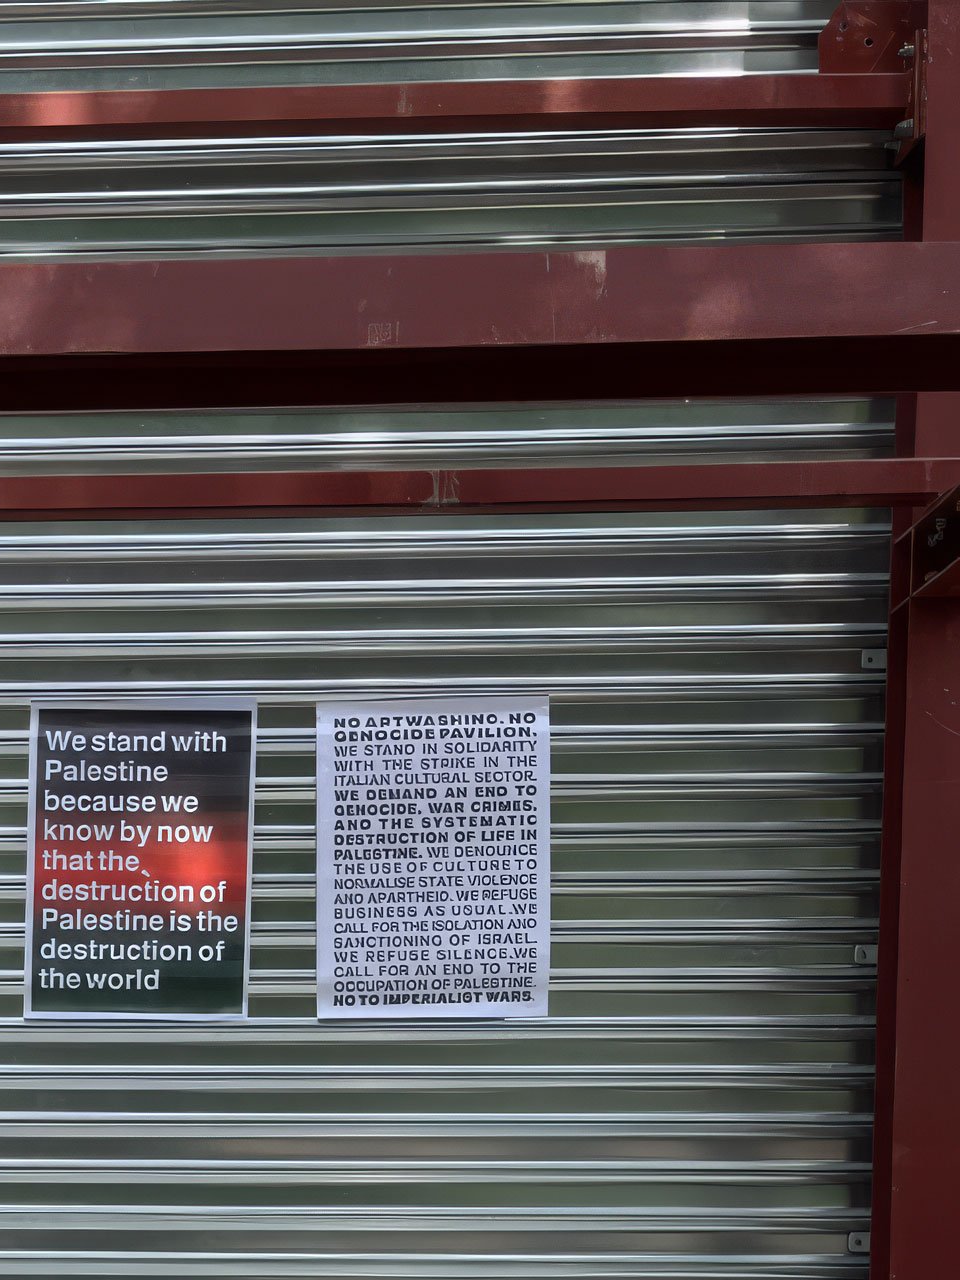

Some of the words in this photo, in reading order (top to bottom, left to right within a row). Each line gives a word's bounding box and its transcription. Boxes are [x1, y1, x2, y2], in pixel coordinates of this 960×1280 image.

[335, 718, 360, 728] NO
[365, 714, 504, 728] ARTWASHING.
[509, 713, 536, 723] NO
[45, 730, 86, 751] We
[91, 731, 166, 752] stand
[171, 731, 227, 753] with
[335, 729, 434, 742] GENOCIDE
[335, 746, 357, 757] WE
[364, 744, 414, 756] STAND
[423, 743, 437, 754] IN
[445, 741, 537, 753] SOLIDARITY
[45, 759, 169, 782] Palestine
[335, 760, 373, 771] WITH
[382, 759, 412, 770] THE
[421, 757, 475, 769] STRIKE
[484, 756, 498, 768] IN
[507, 755, 537, 767] THE
[335, 774, 390, 786] ITALIAN
[395, 773, 469, 785] CULTURAL
[335, 790, 359, 801] WE
[367, 788, 437, 800] DEMAND
[445, 787, 467, 798] AN
[475, 786, 508, 797] END
[515, 785, 537, 796] TO
[45, 790, 156, 812] because
[161, 794, 199, 813] we
[428, 802, 464, 813] WAR
[335, 819, 371, 830] AND
[379, 818, 414, 829] THE
[422, 815, 537, 828] SYSTEMATIC
[44, 819, 115, 841] know
[120, 820, 151, 847] by
[157, 824, 214, 842] now
[335, 832, 448, 845] DESTRUCTION
[455, 832, 476, 842] OF
[482, 830, 514, 841] LIFE
[521, 829, 537, 840] IN
[42, 849, 93, 871] that
[97, 850, 140, 871] the
[335, 848, 423, 860] PALESTINE.
[427, 847, 449, 858] WE
[455, 844, 537, 857] DENOUNCE
[334, 863, 365, 874] THE
[370, 862, 402, 874] USE
[407, 862, 427, 873] OF
[433, 860, 510, 872] CULTURE
[515, 859, 537, 870] TO
[335, 877, 415, 889] NORMALISE
[419, 876, 463, 887] STATE
[468, 874, 537, 886] VIOLENCE
[41, 879, 194, 902] destruction
[199, 881, 227, 903] of
[335, 893, 364, 904] AND
[482, 888, 537, 900] REFUSE
[42, 908, 164, 931] Palestine
[169, 910, 191, 931] is
[196, 910, 238, 932] the
[335, 906, 417, 919] BUSINESS
[424, 906, 445, 916] AS
[335, 923, 368, 933] CALL
[372, 922, 398, 932] FOR
[403, 921, 429, 931] THE
[433, 919, 503, 931] ISOLATION
[507, 918, 537, 929] AND
[335, 935, 442, 948] SANCTIONING
[449, 934, 470, 946] OF
[40, 938, 191, 961] destruction
[198, 941, 226, 961] of
[335, 951, 358, 962] WE
[366, 950, 429, 962] REFUSE
[335, 966, 373, 977] CALL
[379, 965, 408, 976] FOR
[415, 965, 436, 976] AN
[444, 964, 473, 975] END
[480, 963, 500, 974] TO
[507, 962, 537, 973] THE
[39, 968, 81, 989] the
[86, 969, 160, 990] world
[334, 980, 427, 992] OCCUPATION
[432, 979, 450, 989] OF
[454, 977, 537, 988] PALESTINE.
[334, 995, 355, 1006] NO
[359, 994, 379, 1005] TO
[384, 992, 483, 1005] IMPERIALIST
